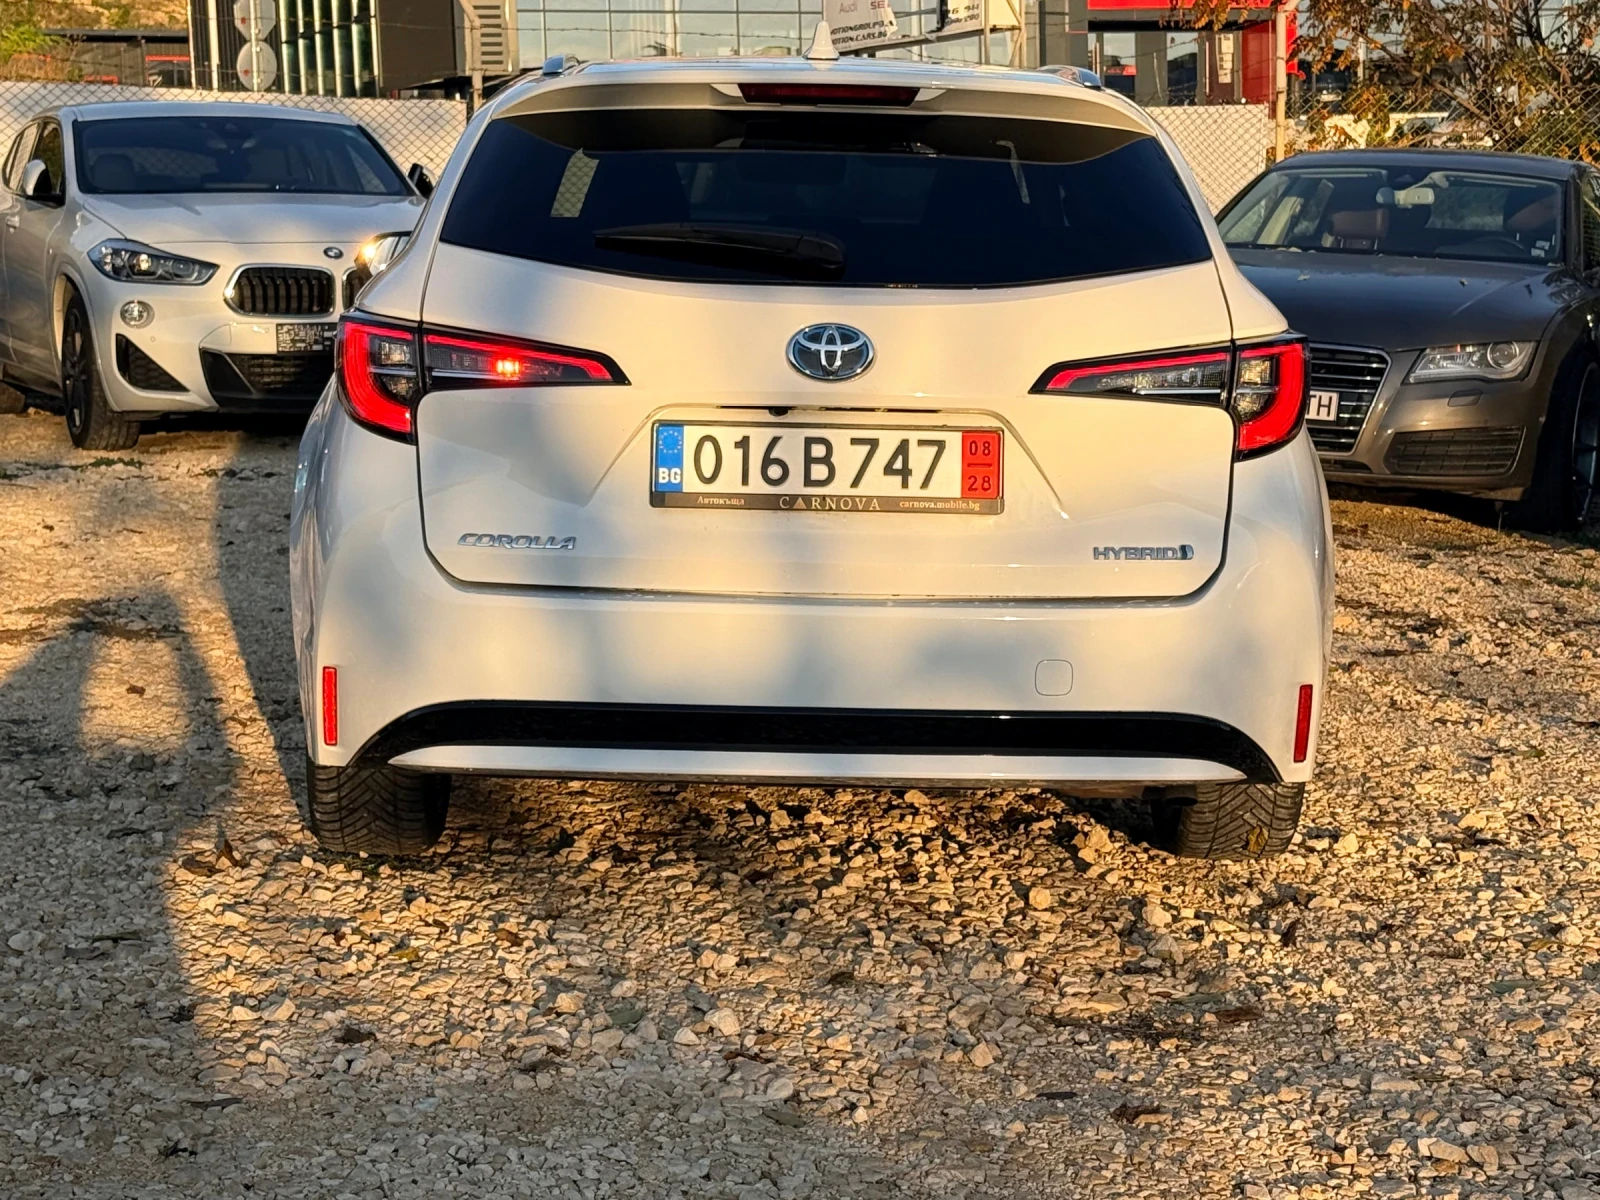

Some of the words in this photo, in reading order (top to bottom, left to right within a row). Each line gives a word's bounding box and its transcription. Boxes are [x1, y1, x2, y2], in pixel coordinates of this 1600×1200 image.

[969, 440, 992, 456] 08
[658, 468, 681, 484] BG
[968, 475, 992, 491] 28
[697, 496, 745, 506] Автокъща
[779, 496, 881, 511] CARNOVA
[899, 500, 980, 511] carnova.mobile.bg
[458, 533, 577, 550] COROLLA
[1093, 546, 1179, 560] HYBRID
